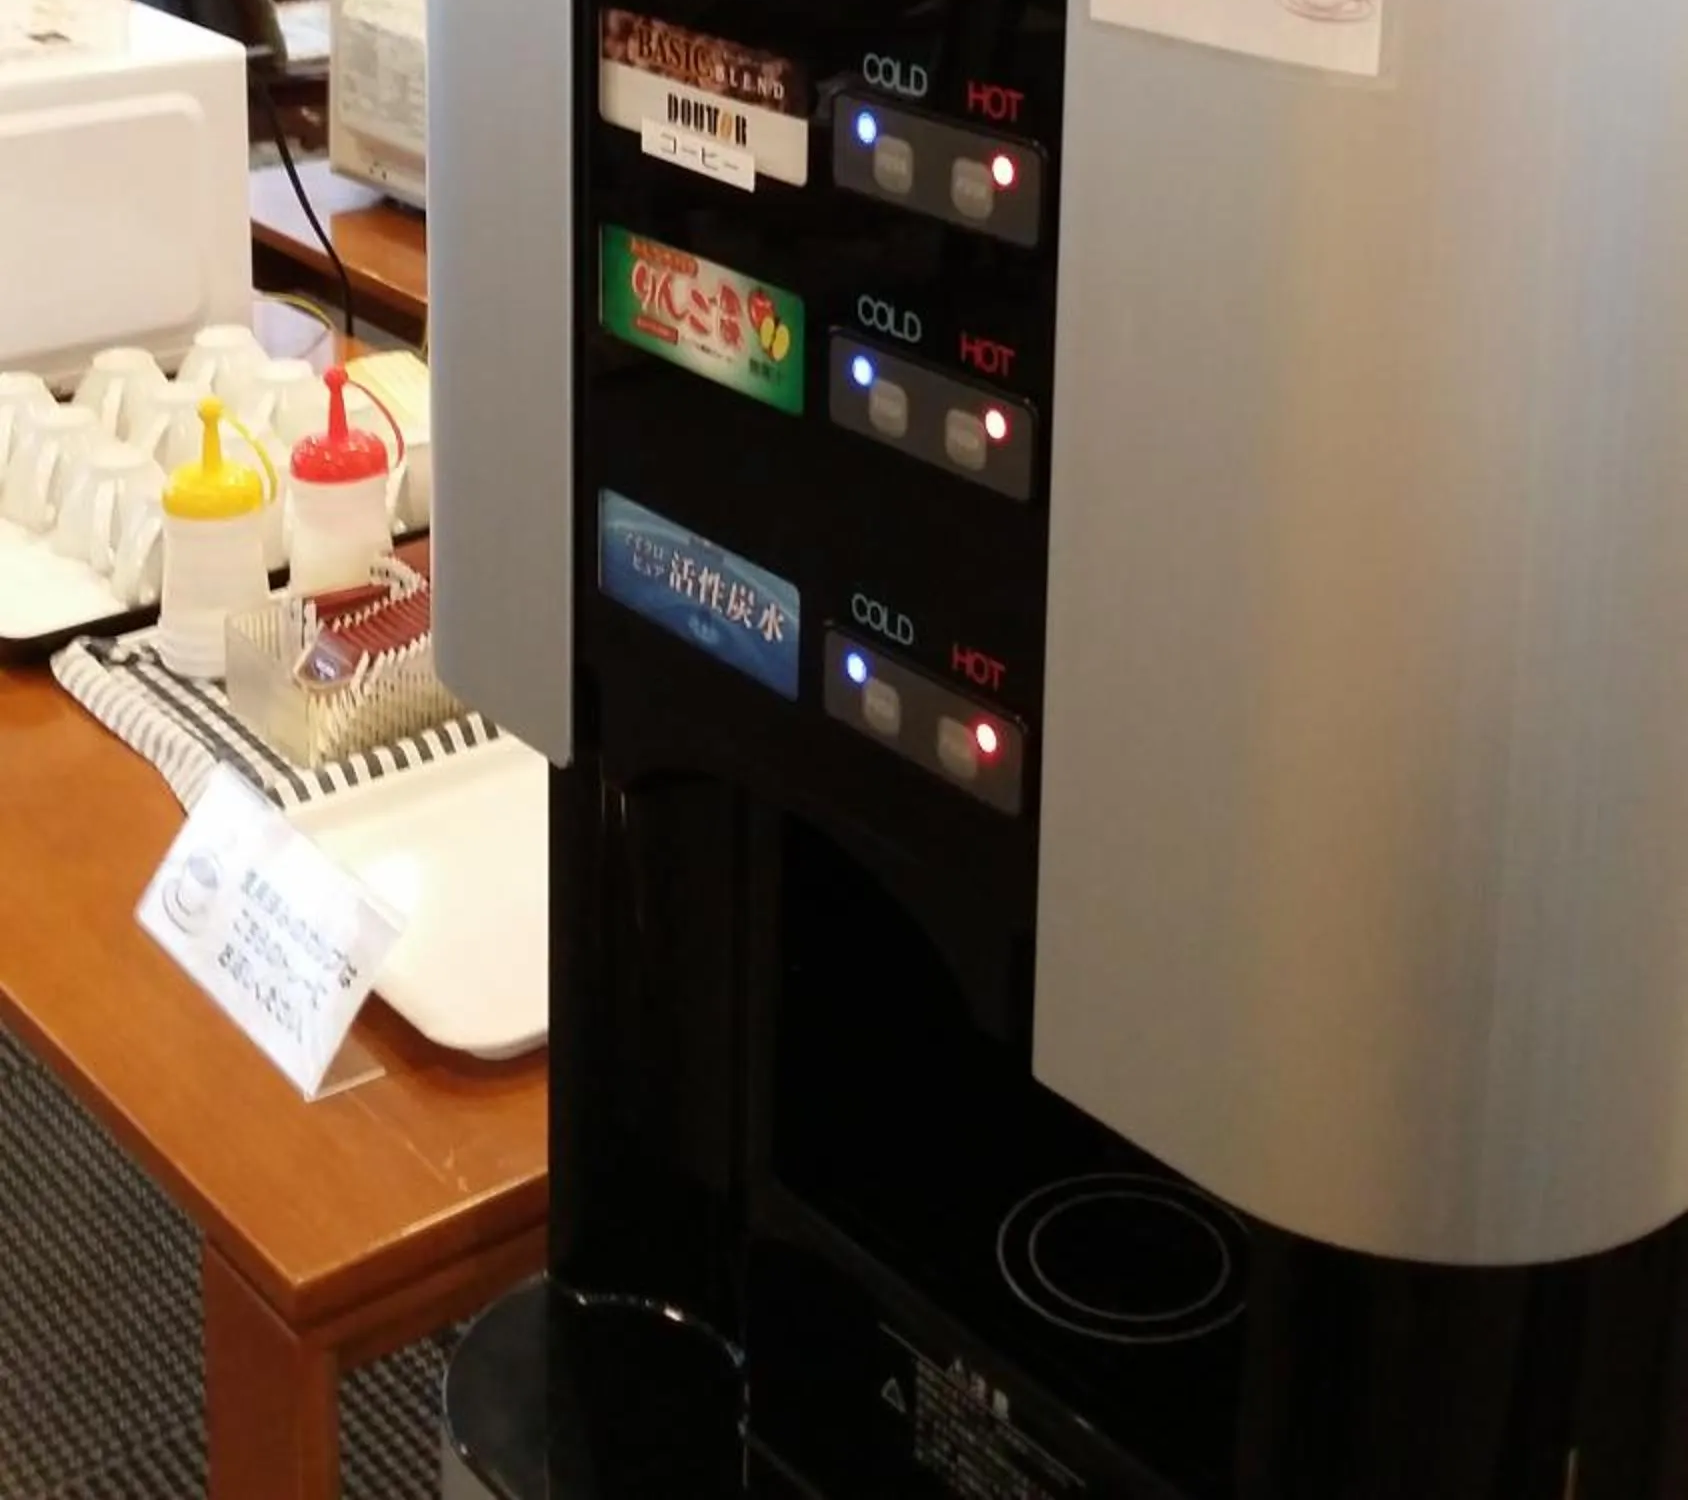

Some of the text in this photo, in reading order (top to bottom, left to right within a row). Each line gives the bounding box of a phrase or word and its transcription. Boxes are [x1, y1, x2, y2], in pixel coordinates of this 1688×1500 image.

[637, 25, 713, 79] BASIC
[863, 52, 928, 97] COLD
[714, 63, 785, 100] BLEND
[968, 81, 1024, 122] HOT
[660, 133, 740, 172] コーヒー
[858, 295, 922, 344] COLD
[960, 333, 1015, 376] HOT
[669, 551, 785, 642] 活性炭水
[851, 593, 914, 646] COLD
[952, 644, 1005, 691] HOT
